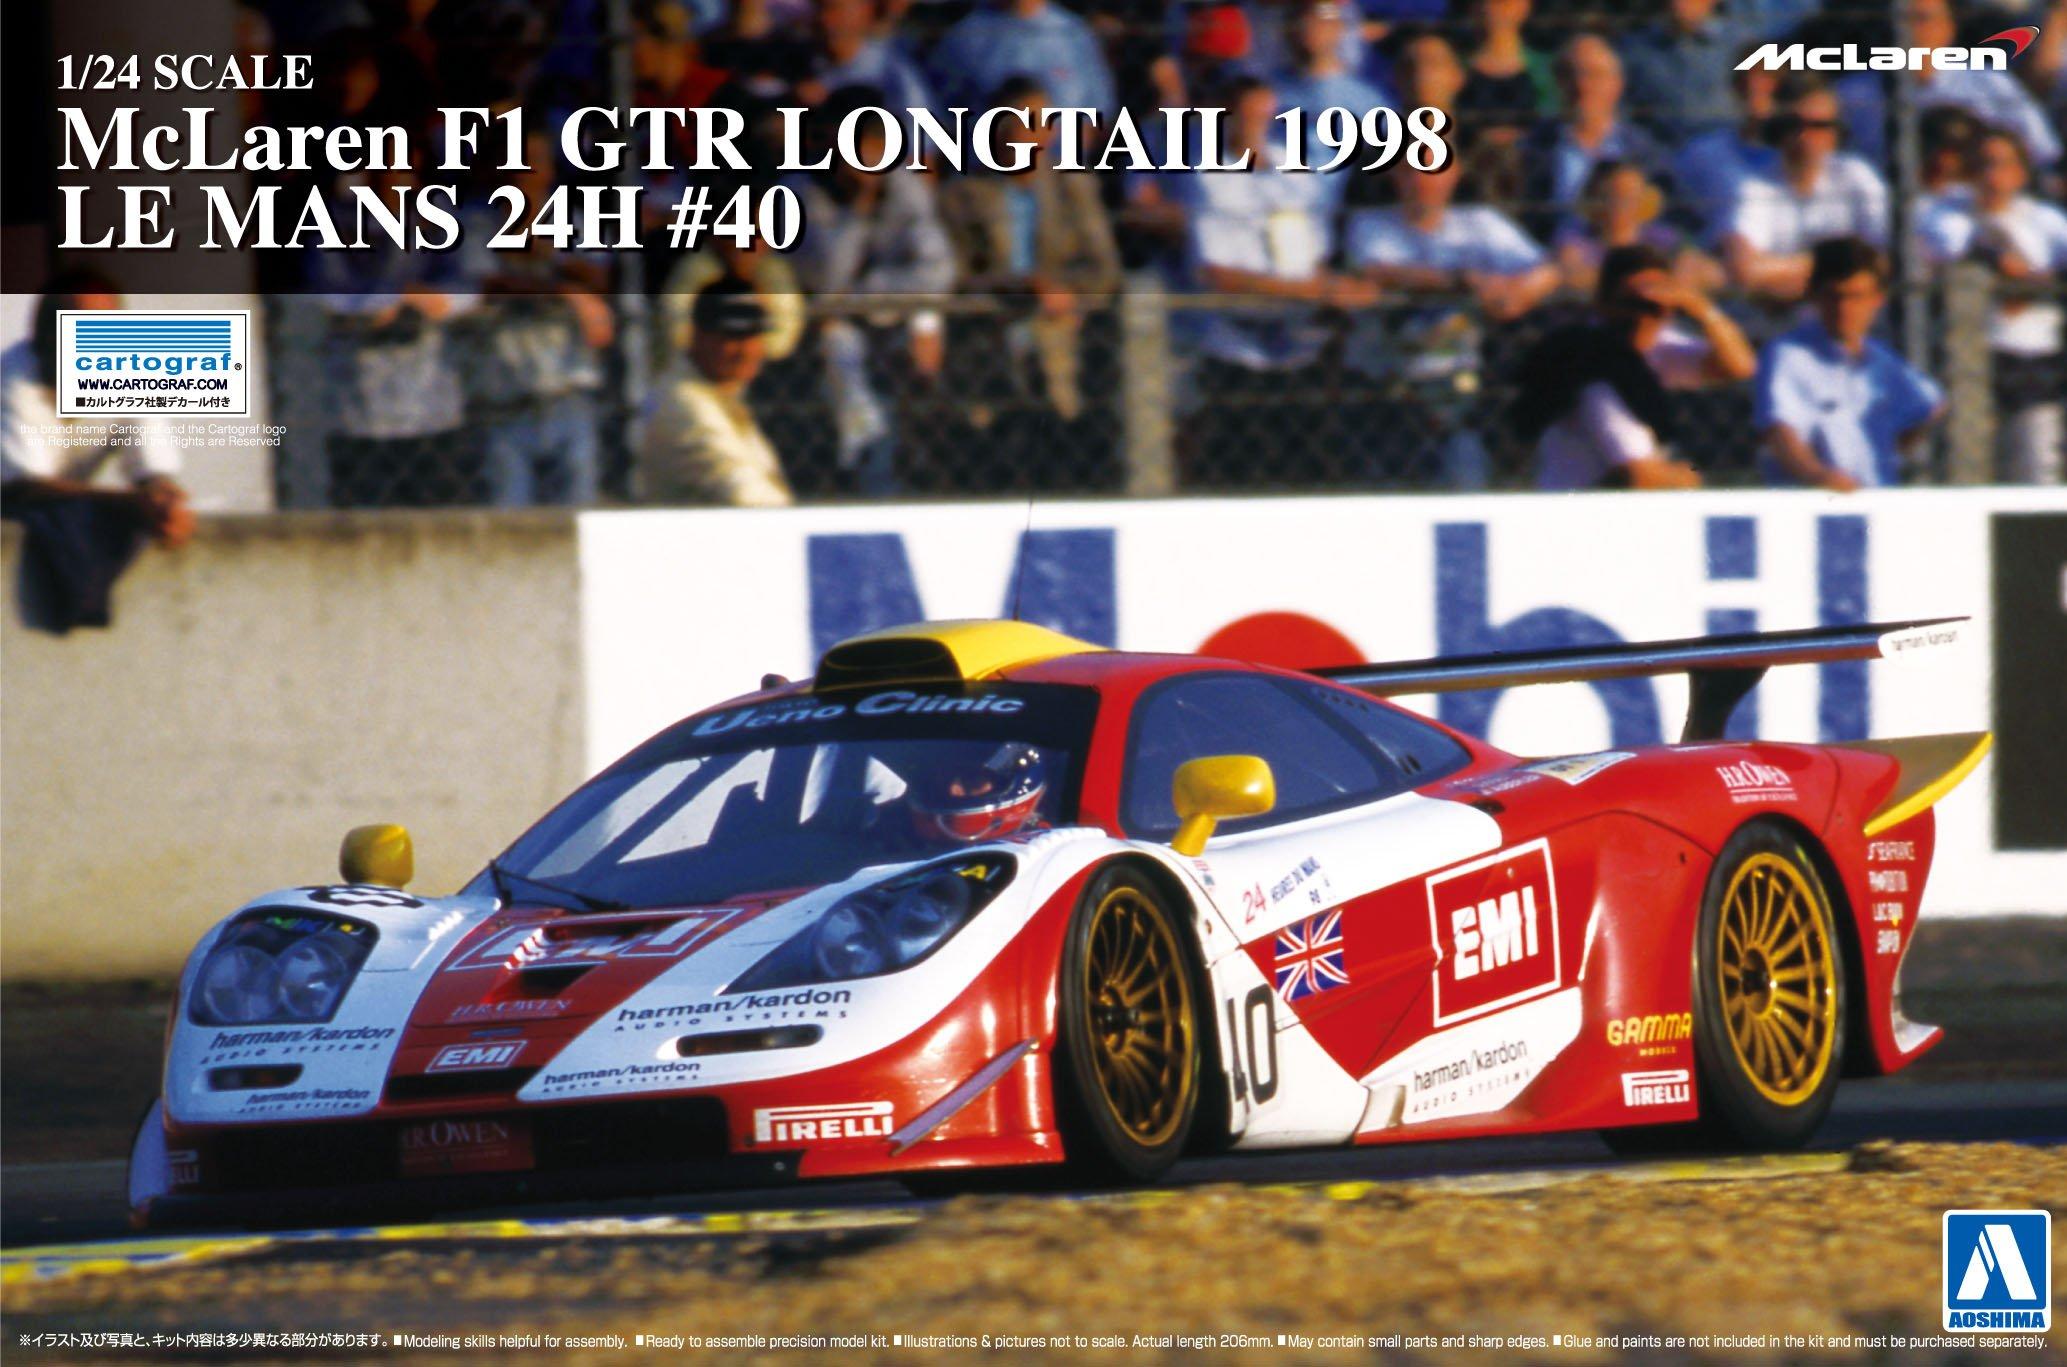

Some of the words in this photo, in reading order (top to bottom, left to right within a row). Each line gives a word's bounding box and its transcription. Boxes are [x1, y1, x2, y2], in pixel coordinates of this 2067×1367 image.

[854, 689, 1026, 716] Clinic
[1242, 881, 1267, 925] 24
[1451, 885, 1539, 981] EMI
[614, 1017, 702, 1032] AUDIO
[725, 1009, 848, 1023] SYSTEMS
[617, 987, 851, 1024] harman/kardon
[209, 1026, 396, 1050] harman/kardon
[1606, 1012, 1693, 1047] GAMMA
[200, 1048, 267, 1065] AUDIO
[436, 1045, 516, 1067] EMI
[1412, 1039, 1529, 1093] harman/kardon
[543, 1060, 702, 1086] harman/kardon
[1620, 1069, 1690, 1107] PIRELLI
[246, 1088, 370, 1105] harman/kardon
[753, 1100, 895, 1143] PIRELLI
